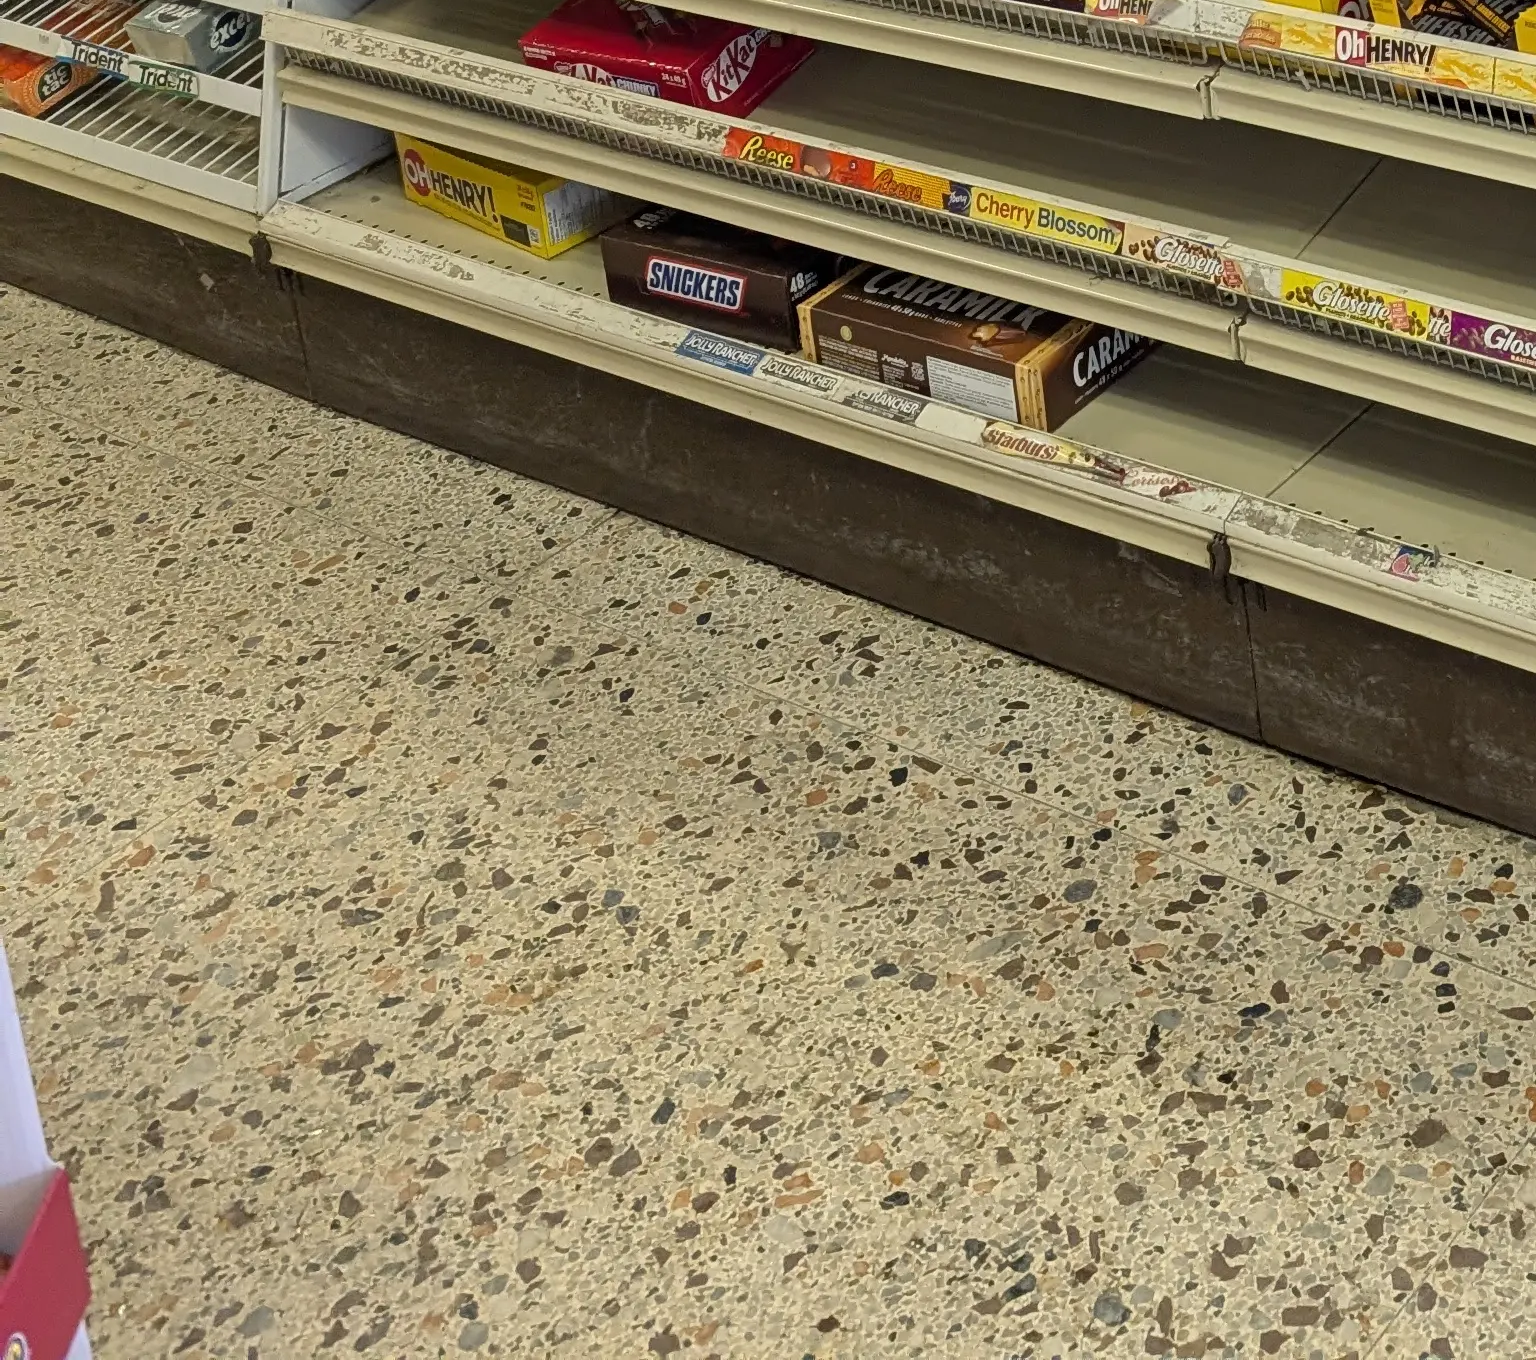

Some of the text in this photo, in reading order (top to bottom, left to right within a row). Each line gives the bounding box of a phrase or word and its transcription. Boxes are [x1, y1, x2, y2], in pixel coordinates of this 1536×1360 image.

[71, 42, 124, 74] Trident
[1336, 28, 1436, 72] Oh HENRY!
[139, 65, 194, 92] Trident
[432, 173, 496, 220] HENRY!
[974, 191, 1117, 246] Cherry Blossom
[647, 258, 745, 309] SNICKERS
[1312, 282, 1390, 322] Glosette
